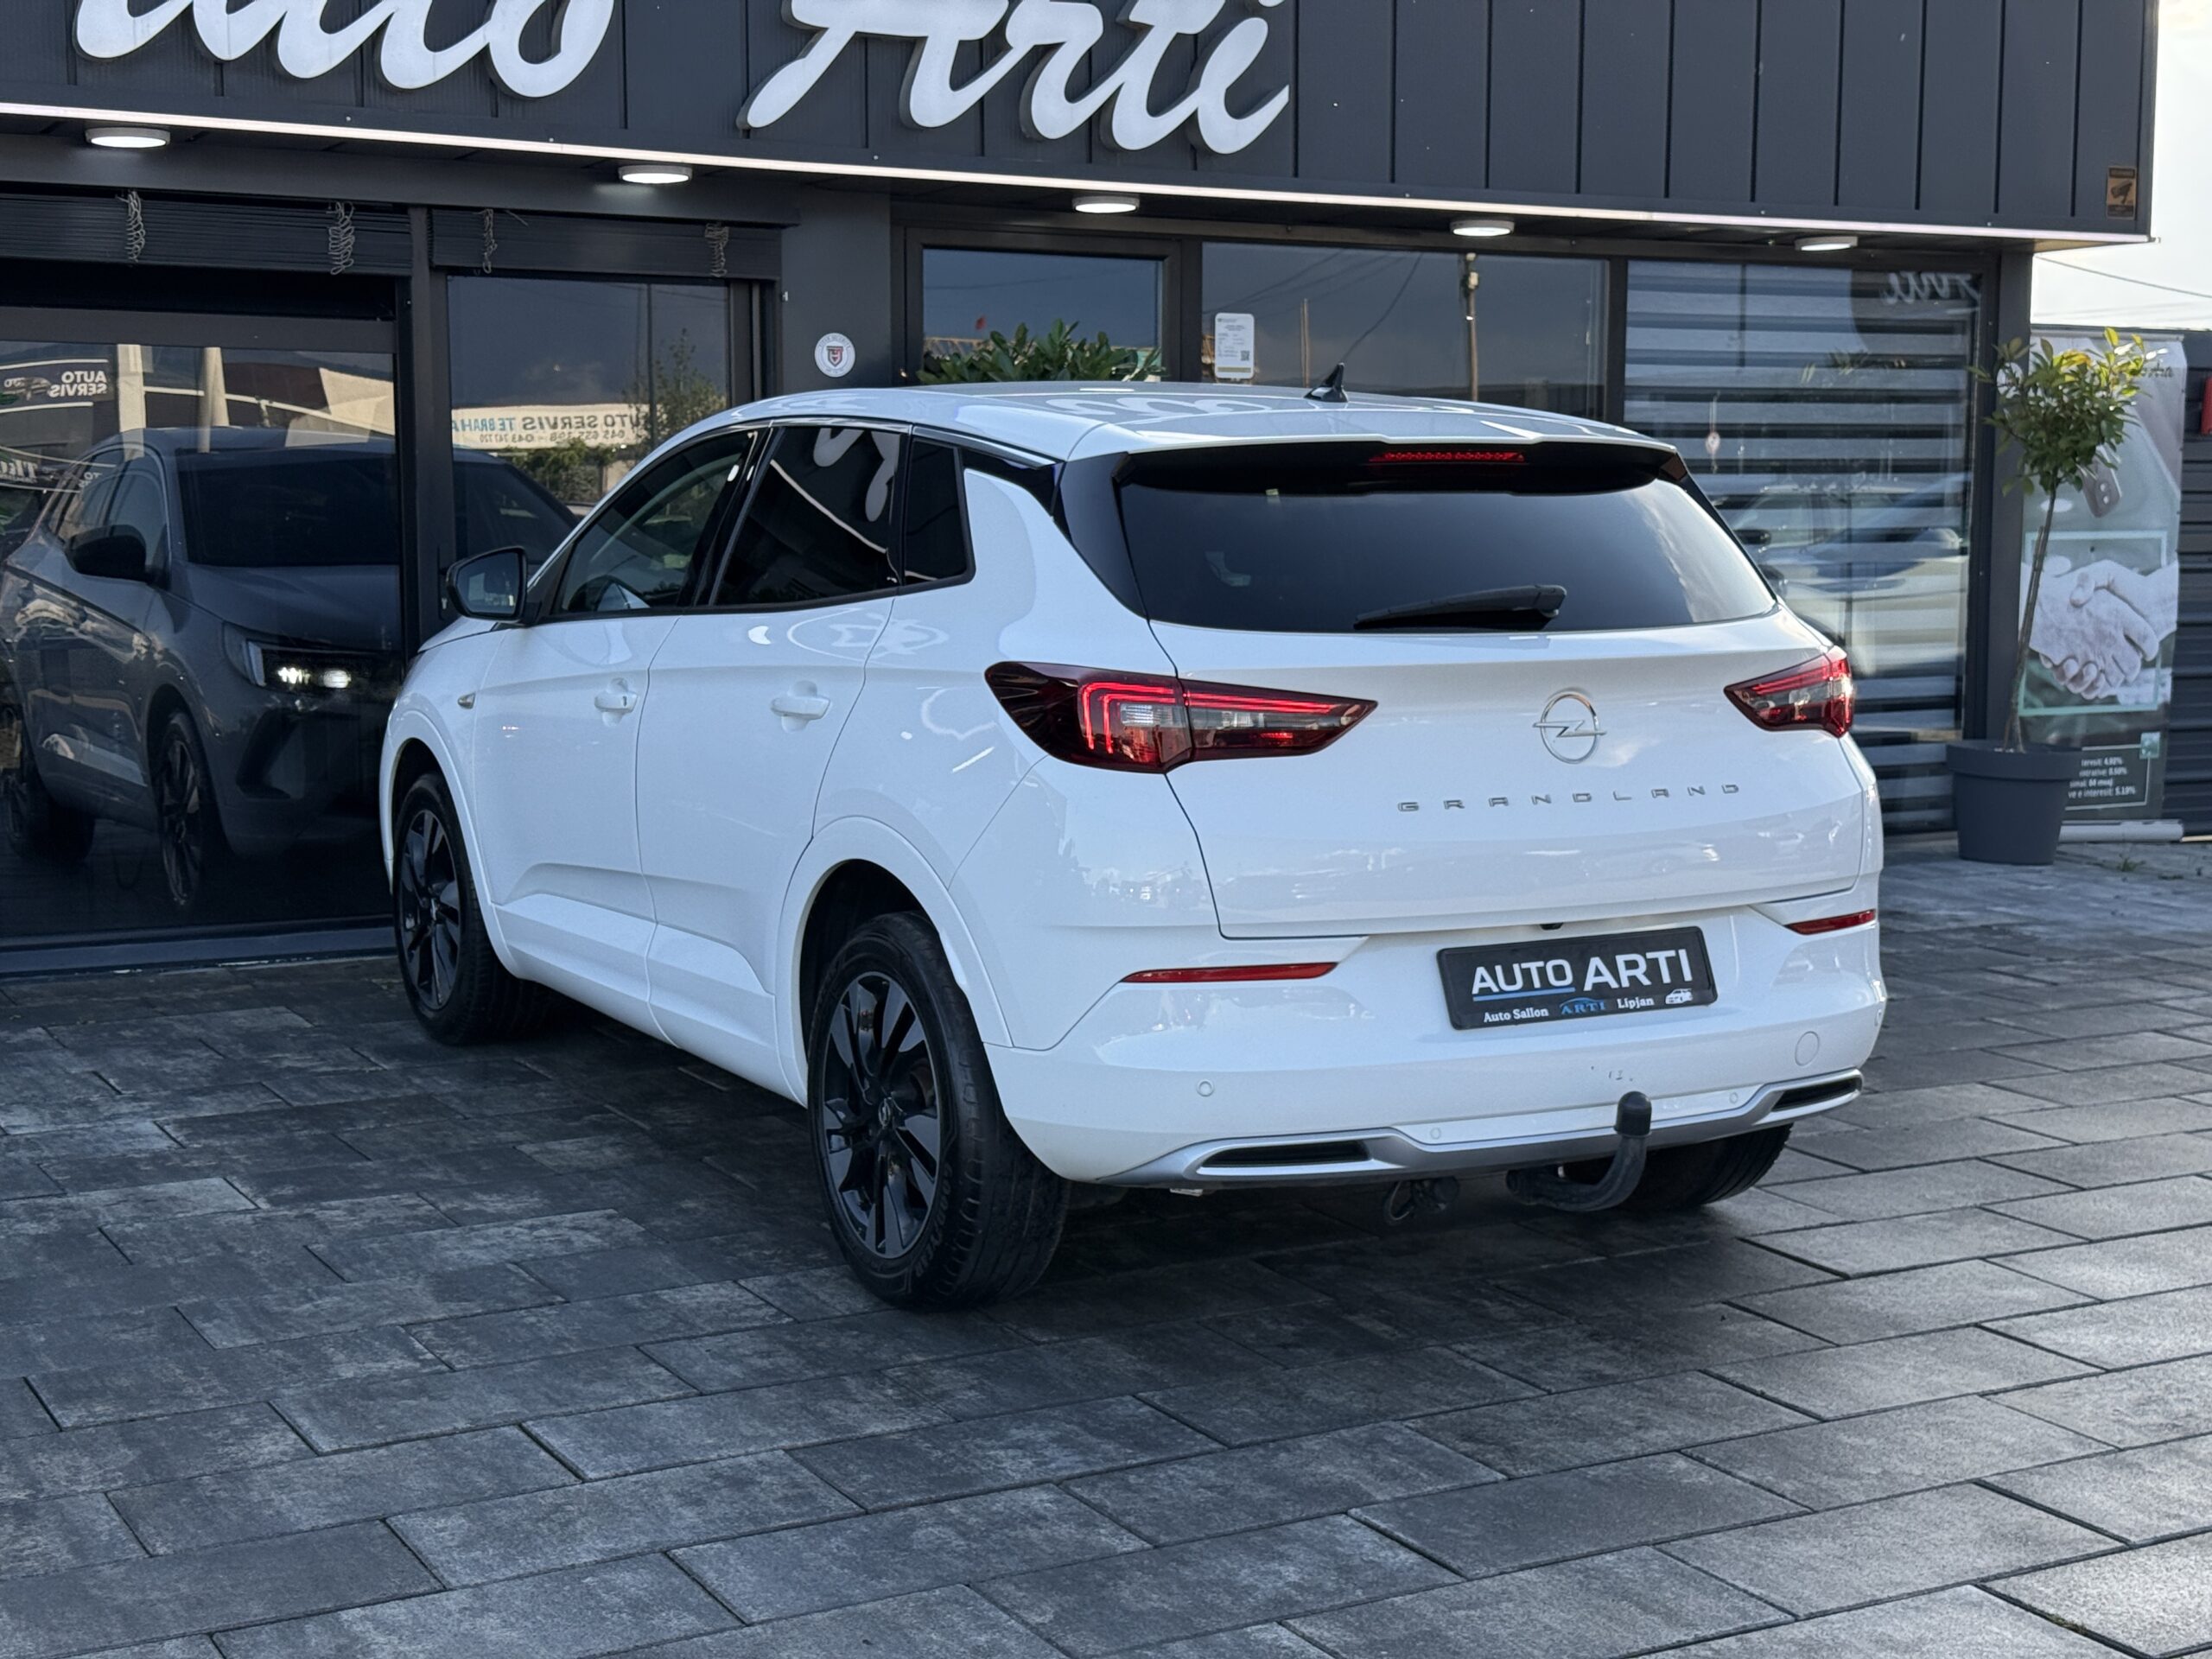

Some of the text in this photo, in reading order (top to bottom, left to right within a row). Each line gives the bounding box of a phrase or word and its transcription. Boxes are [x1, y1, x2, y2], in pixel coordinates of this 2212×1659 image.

[1398, 784, 1739, 812] GRANDLAND
[1471, 948, 1694, 995] AUTO ARTI
[1483, 995, 1655, 1023] Auto Sallon ARTI Lipjan
